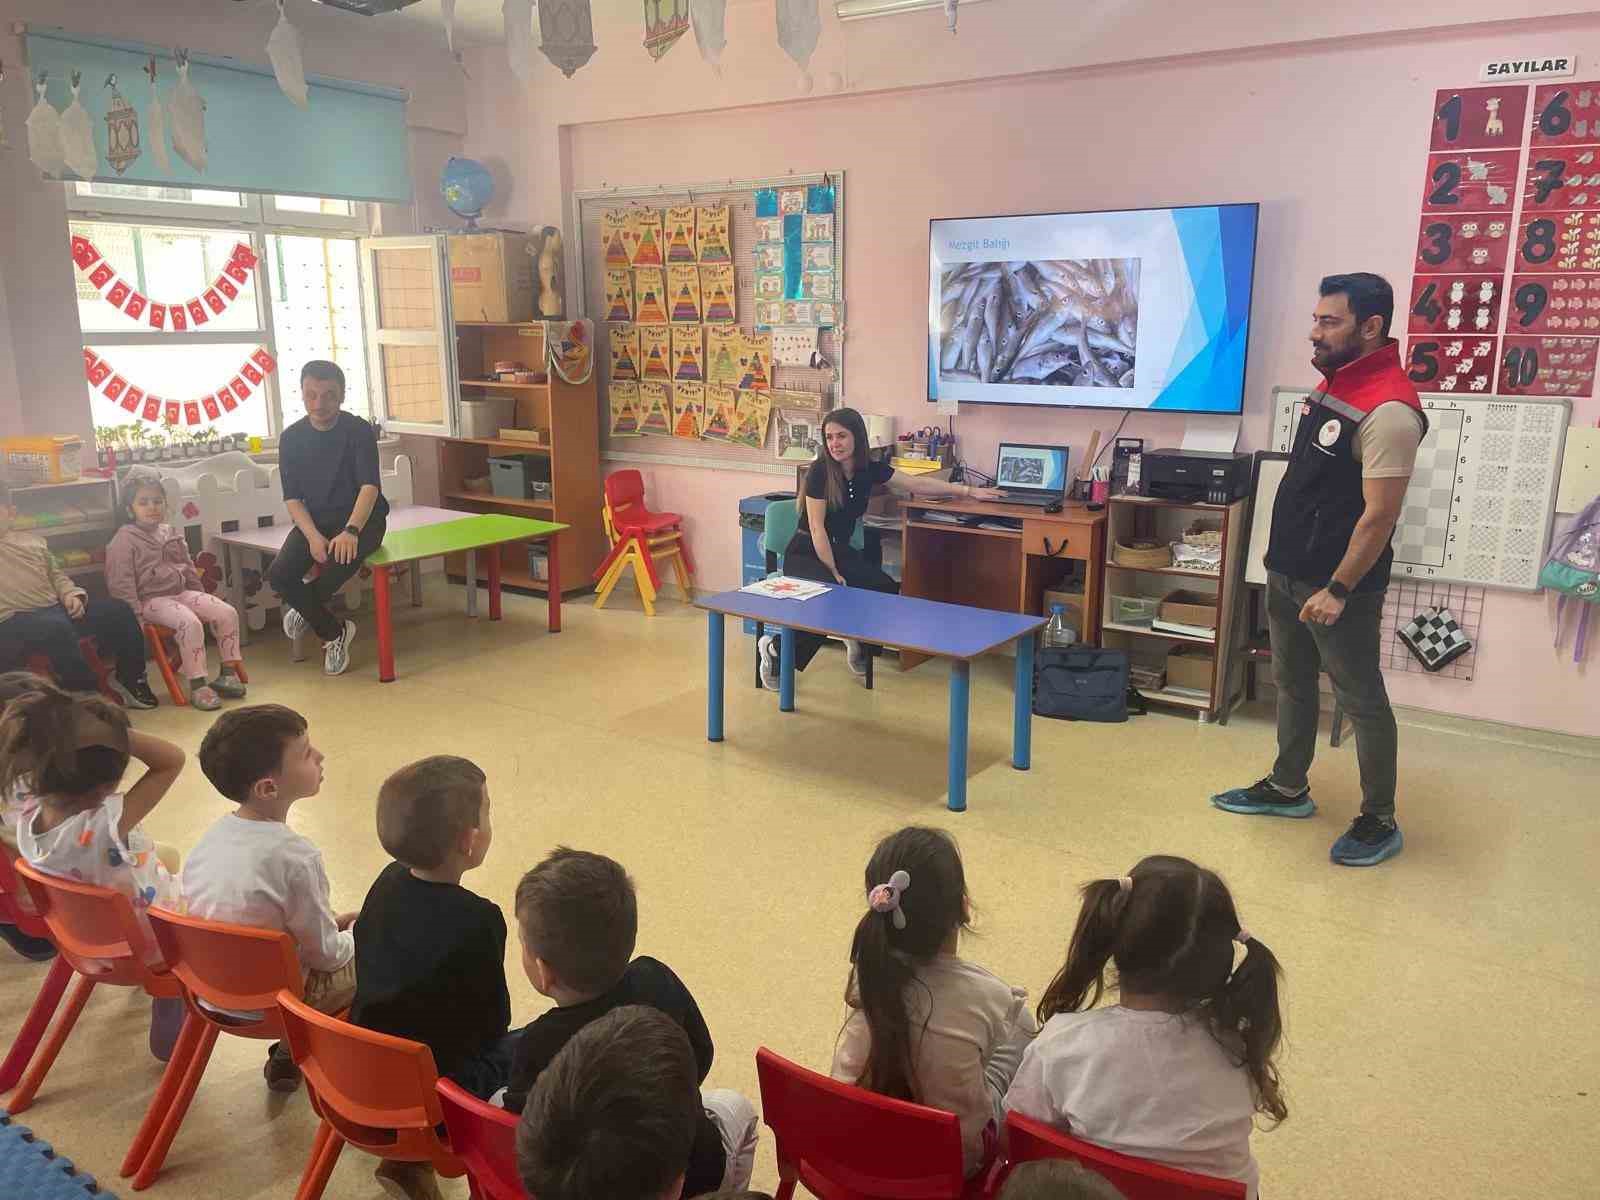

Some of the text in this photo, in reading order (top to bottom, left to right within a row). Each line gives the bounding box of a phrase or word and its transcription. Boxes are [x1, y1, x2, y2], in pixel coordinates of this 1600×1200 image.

[1487, 59, 1568, 75] SAYILAR
[1438, 95, 1461, 141] 1
[1540, 91, 1571, 136] 6
[1429, 161, 1461, 204] 2
[1535, 160, 1566, 203] 7
[1422, 223, 1452, 265] 3
[1522, 219, 1556, 264] 8
[1412, 283, 1441, 325] 4
[1515, 283, 1547, 327] 9
[1408, 342, 1440, 382] 5
[1505, 347, 1538, 388] 10
[1463, 435, 1469, 443] 7
[1465, 415, 1472, 423] 8
[1457, 476, 1464, 484] 5
[1460, 456, 1466, 464] 6
[1454, 495, 1461, 503] 4
[1448, 553, 1452, 561] 1
[1449, 534, 1456, 542] 2
